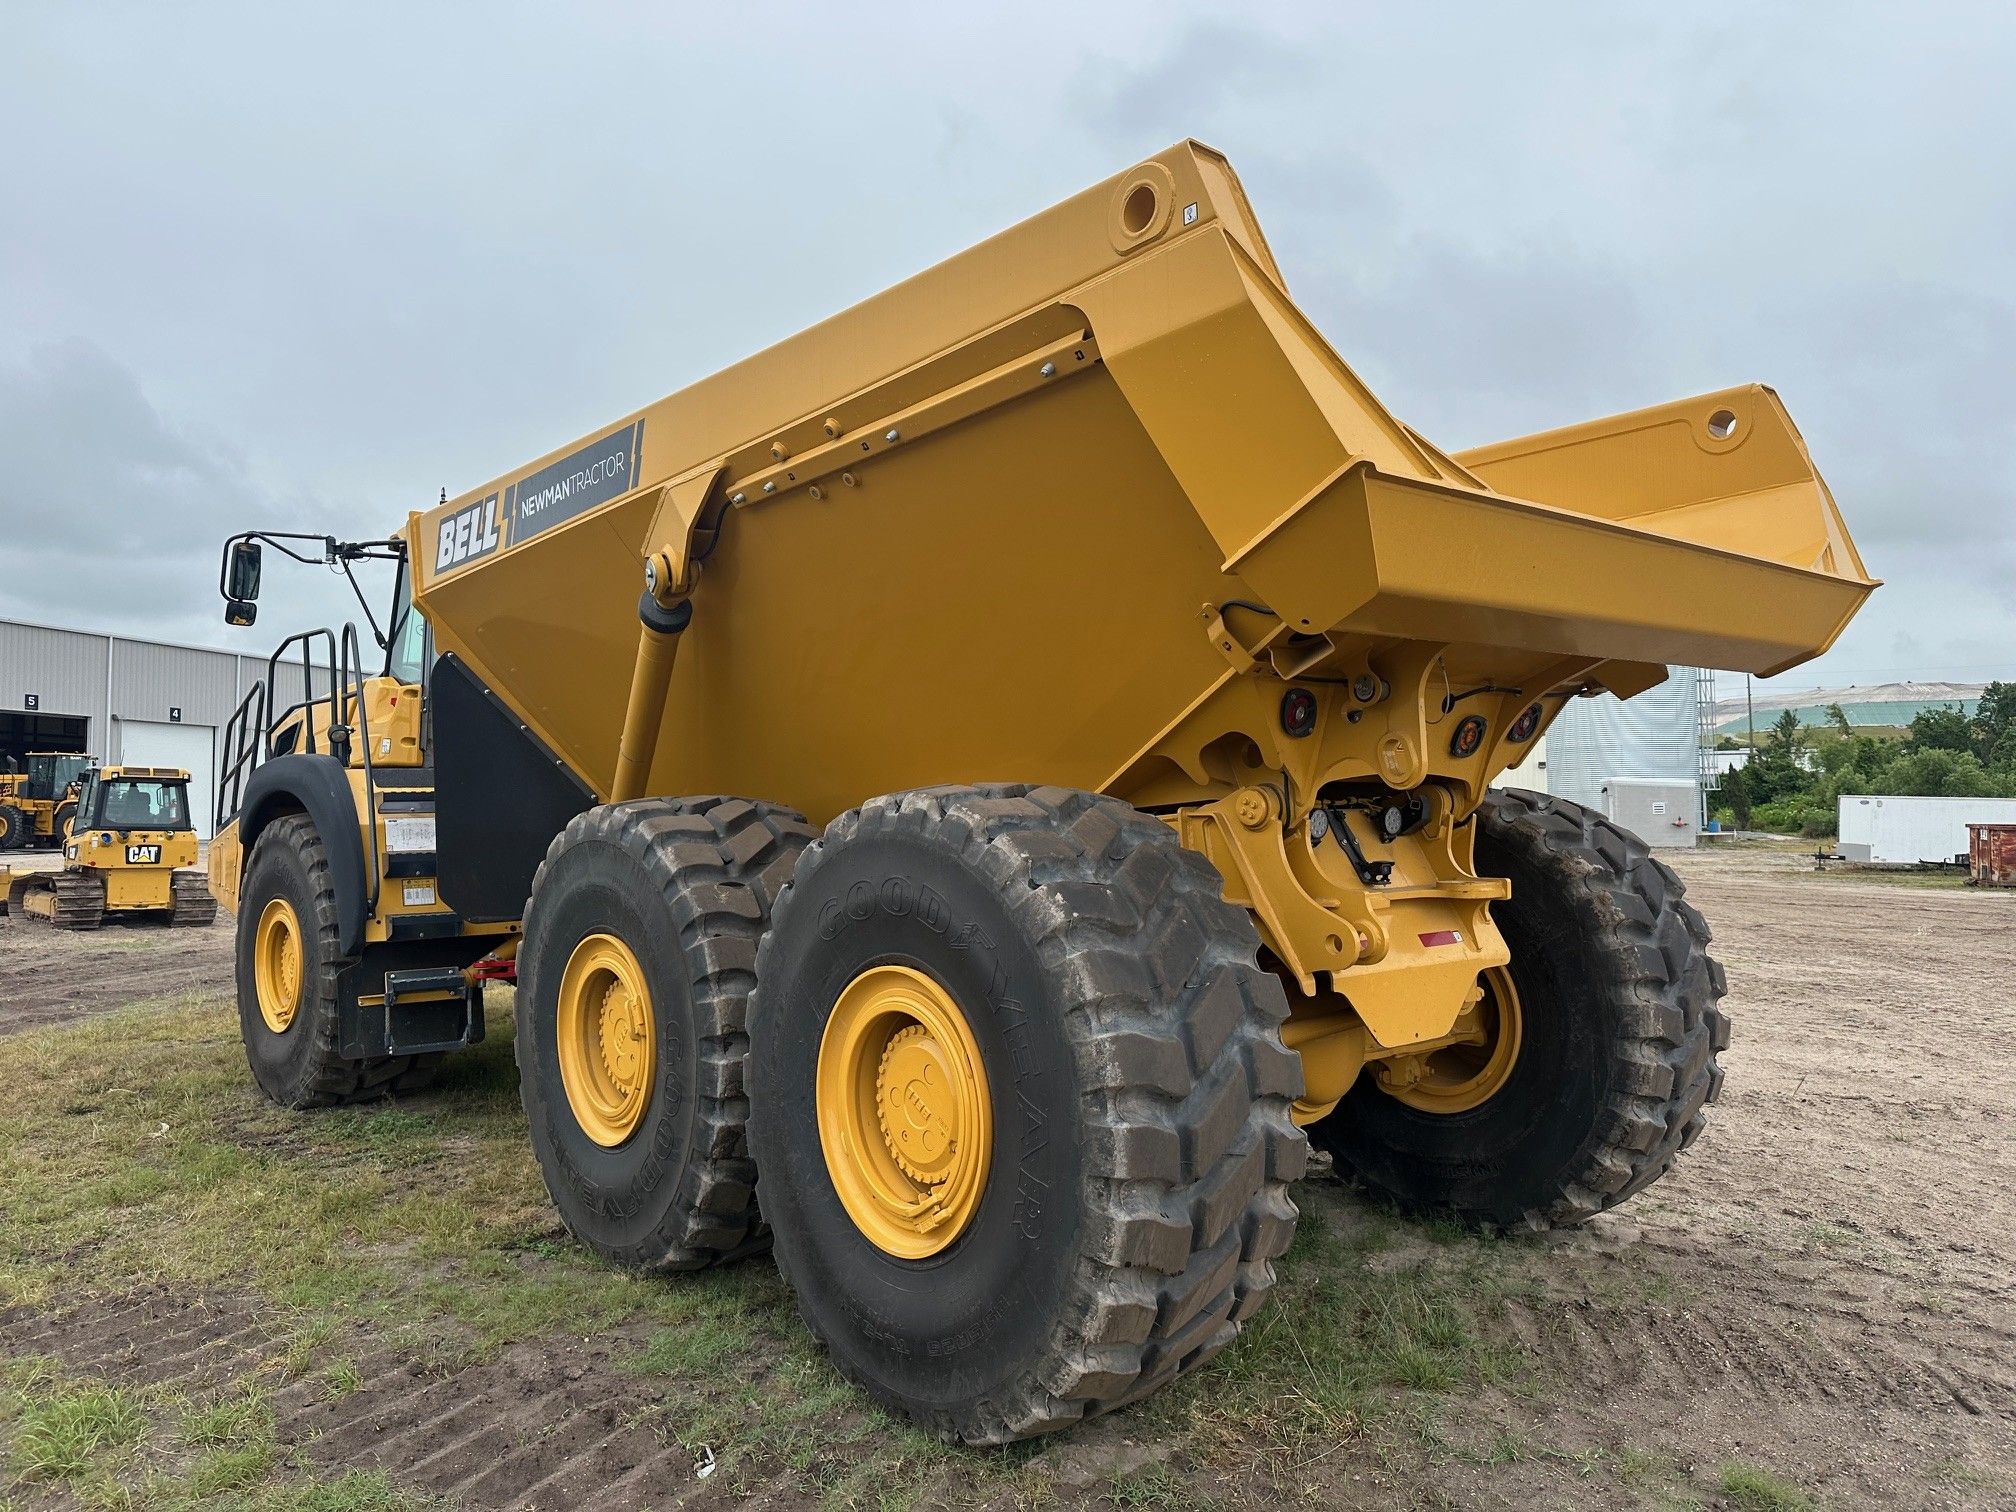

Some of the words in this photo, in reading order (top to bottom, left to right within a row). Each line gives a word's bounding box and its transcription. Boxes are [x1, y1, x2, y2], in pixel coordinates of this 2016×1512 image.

[437, 499, 499, 570] BELL
[28, 696, 36, 706] 5
[172, 709, 179, 718] 4
[128, 846, 159, 862] CAT
